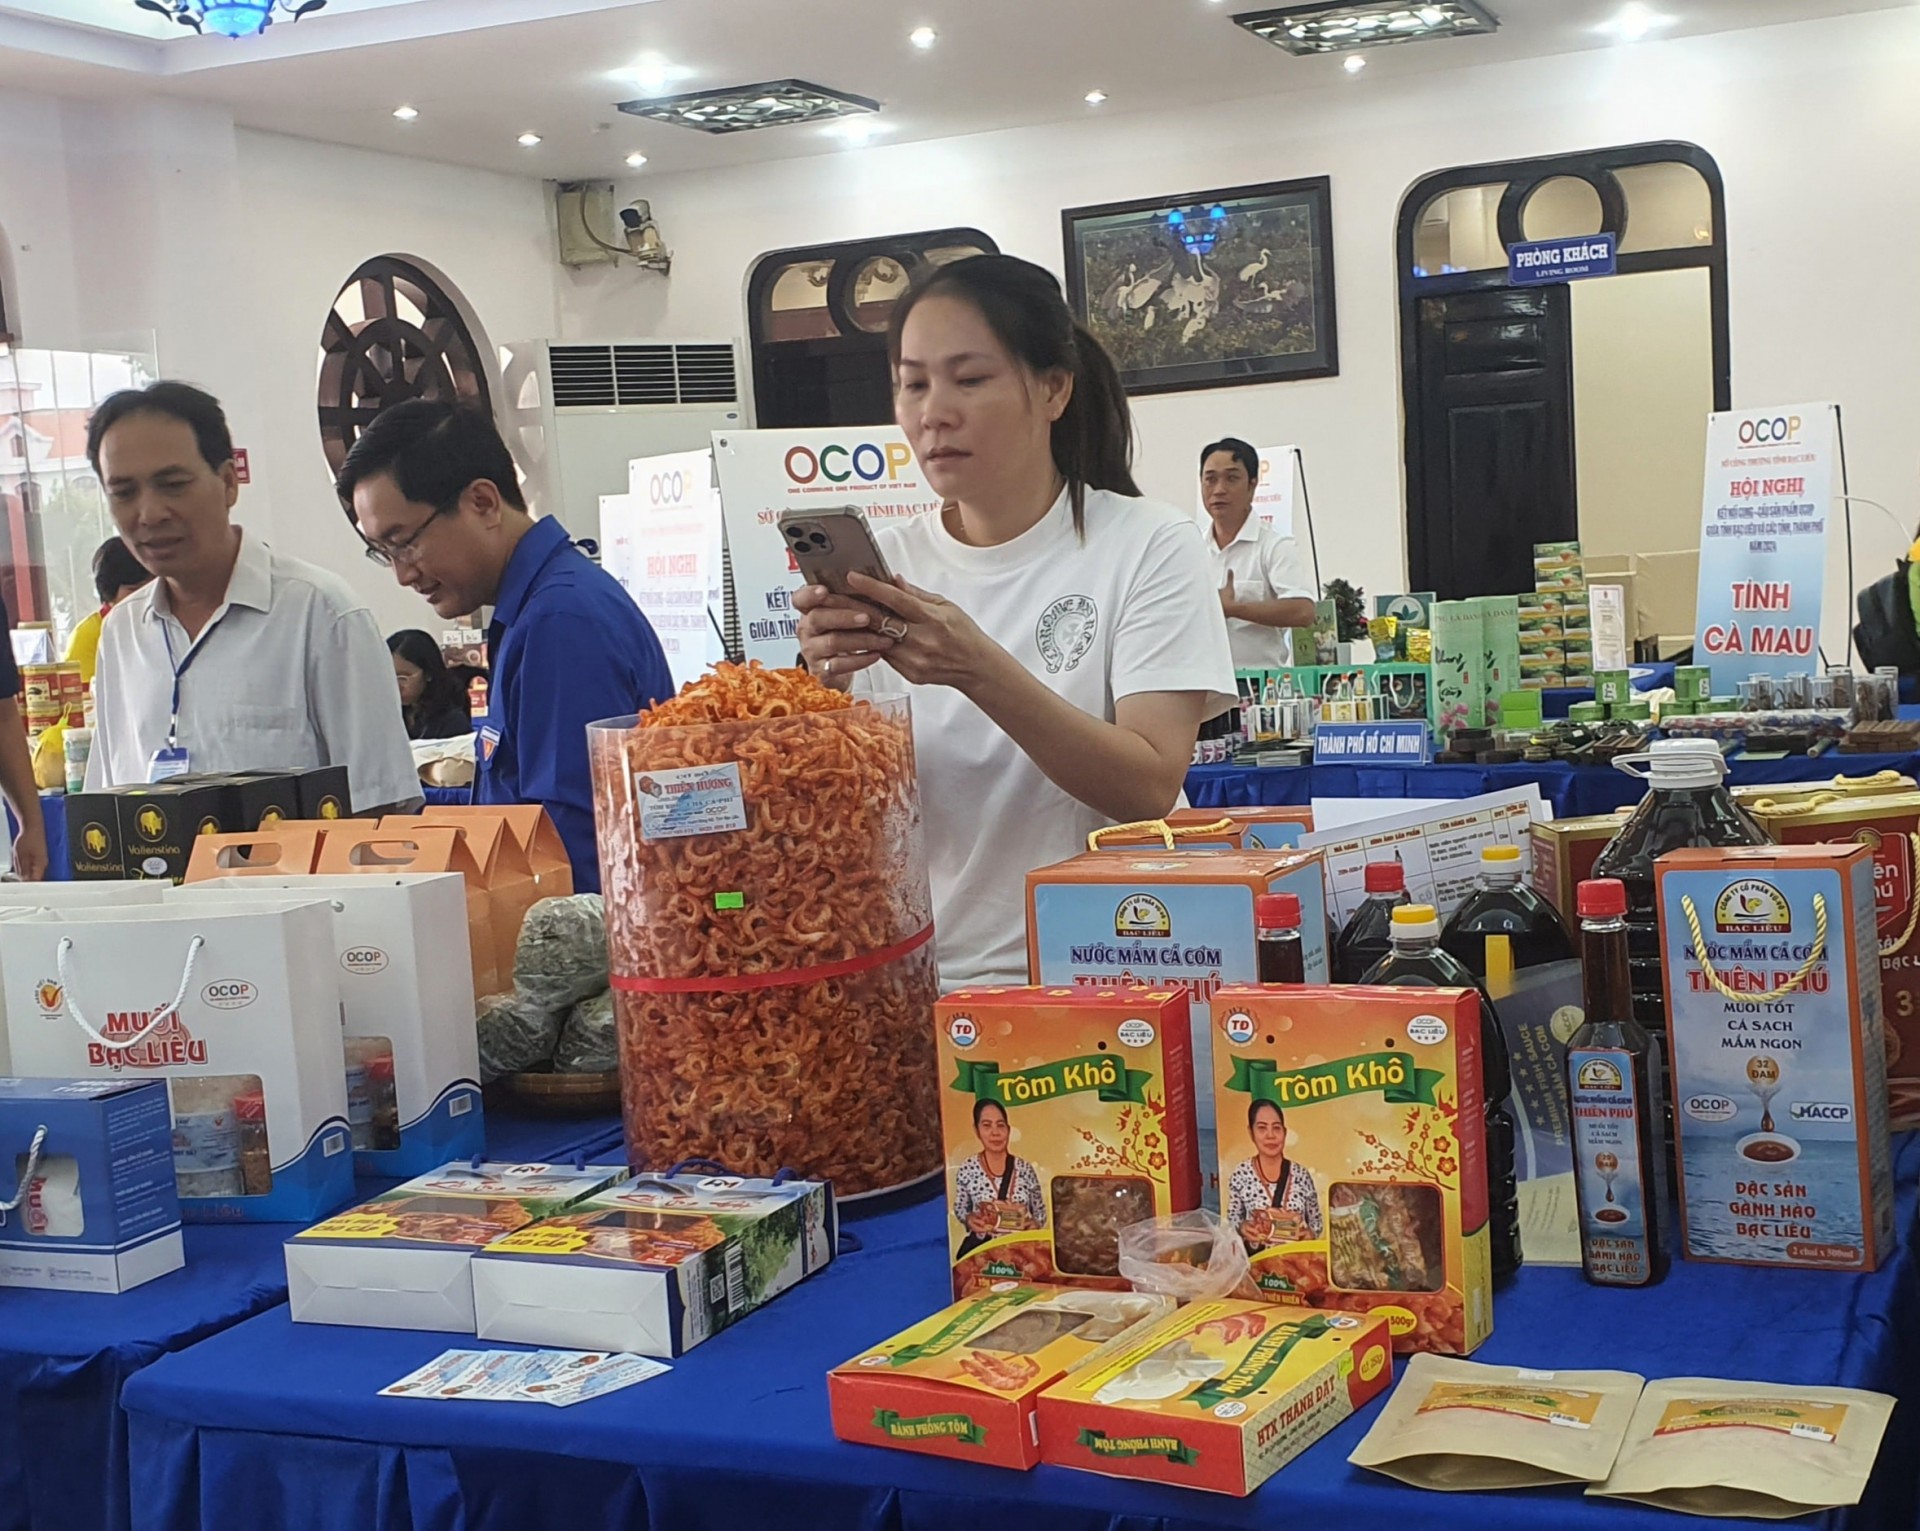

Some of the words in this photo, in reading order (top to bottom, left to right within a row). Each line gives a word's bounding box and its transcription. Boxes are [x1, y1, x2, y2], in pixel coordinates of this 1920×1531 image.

[1516, 247, 1561, 268] PHÒNG
[1562, 242, 1609, 263] KHÁCH
[1536, 268, 1563, 277] LIVING
[1565, 265, 1590, 274] ROOM
[1739, 416, 1801, 444] OCOP
[784, 442, 912, 485] OCOP
[650, 470, 693, 504] OCOP
[1730, 477, 1759, 500] HỘI
[1762, 476, 1805, 498] NGHỊ
[757, 508, 775, 524] SỞ
[865, 503, 894, 518] TỈNH
[766, 585, 790, 612] KẾT
[1732, 580, 1791, 610] TỈNH
[749, 619, 778, 641] GIỮA
[779, 613, 799, 638] TỈN
[1704, 624, 1744, 654] CÀ
[1752, 627, 1812, 654] MAU
[1318, 732, 1346, 754] THÀNH
[1347, 730, 1366, 754] PHỐ
[1396, 735, 1420, 753] MINH
[347, 951, 382, 965] OCOP
[1071, 941, 1116, 964] NƯỚC
[1119, 940, 1157, 965] MẮM
[1160, 944, 1182, 965] CÁ
[1184, 945, 1222, 966] CƠM
[1730, 940, 1767, 961] MẮM
[1771, 940, 1791, 961] CÁ
[208, 984, 250, 997] OCOP
[1763, 1001, 1795, 1014] TỐT
[1728, 1019, 1748, 1031] CÁ
[1752, 1021, 1793, 1034] SẠCH
[1518, 1022, 1538, 1062] SAUCE
[1721, 1036, 1756, 1049] MẮM
[1760, 1038, 1802, 1050] NGON
[87, 1042, 138, 1072] BẠC
[146, 1036, 207, 1065] LIÊU
[1756, 1060, 1769, 1069] 32
[998, 1075, 1056, 1102] Tôm
[1064, 1058, 1117, 1089] Khô
[1274, 1073, 1338, 1102] Tôm
[1346, 1057, 1405, 1085] Khô
[1533, 1063, 1550, 1090] FISH
[1690, 1099, 1730, 1111] OCOP
[1799, 1104, 1849, 1119] HACCP
[1735, 1180, 1769, 1199] ĐẶC
[1773, 1178, 1807, 1198] SẢN
[1736, 1222, 1770, 1240] BẠC
[1774, 1223, 1813, 1240] LIÊU
[991, 1266, 1015, 1275] 100%
[1264, 1278, 1288, 1289] 100%
[1390, 1316, 1415, 1328] 500gr
[891, 1419, 915, 1436] BÁNH
[947, 1418, 968, 1436] TÔM
[1257, 1418, 1279, 1448] HTX
